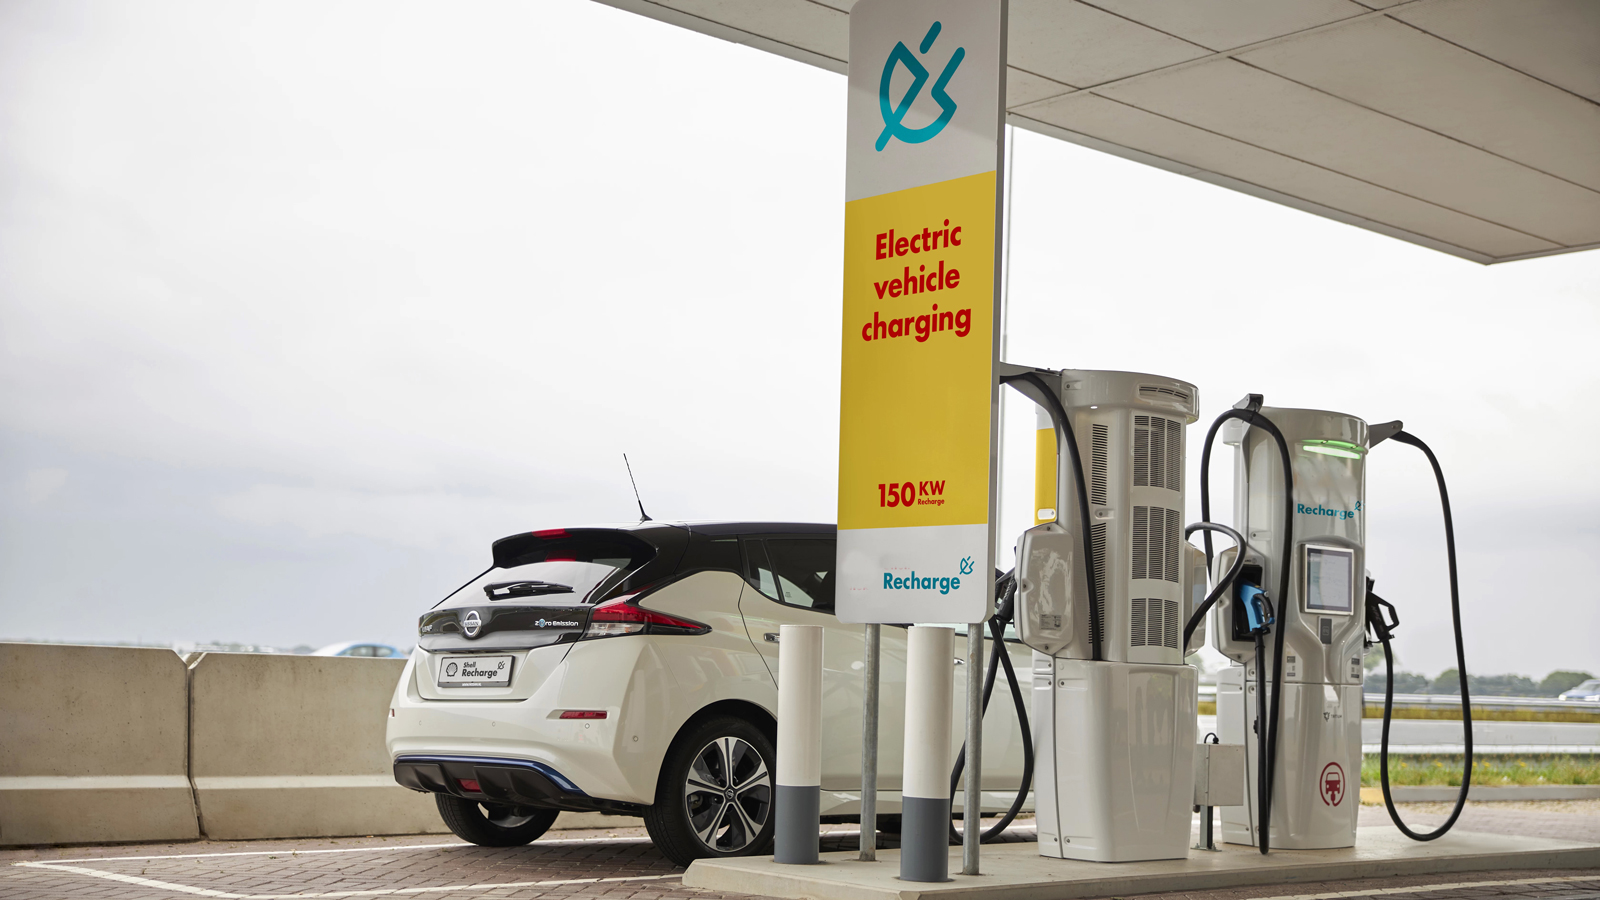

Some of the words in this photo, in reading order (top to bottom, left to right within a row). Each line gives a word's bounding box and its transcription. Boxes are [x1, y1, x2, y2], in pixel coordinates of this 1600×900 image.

[875, 218, 962, 261] Electric
[873, 260, 960, 300] vehicle
[861, 303, 972, 343] charging
[878, 481, 916, 508] 150
[919, 480, 946, 496] KW
[917, 497, 945, 506] Recharge
[1297, 503, 1355, 521] Recharge
[883, 571, 961, 595] Recharge
[461, 668, 498, 679] Recharge
